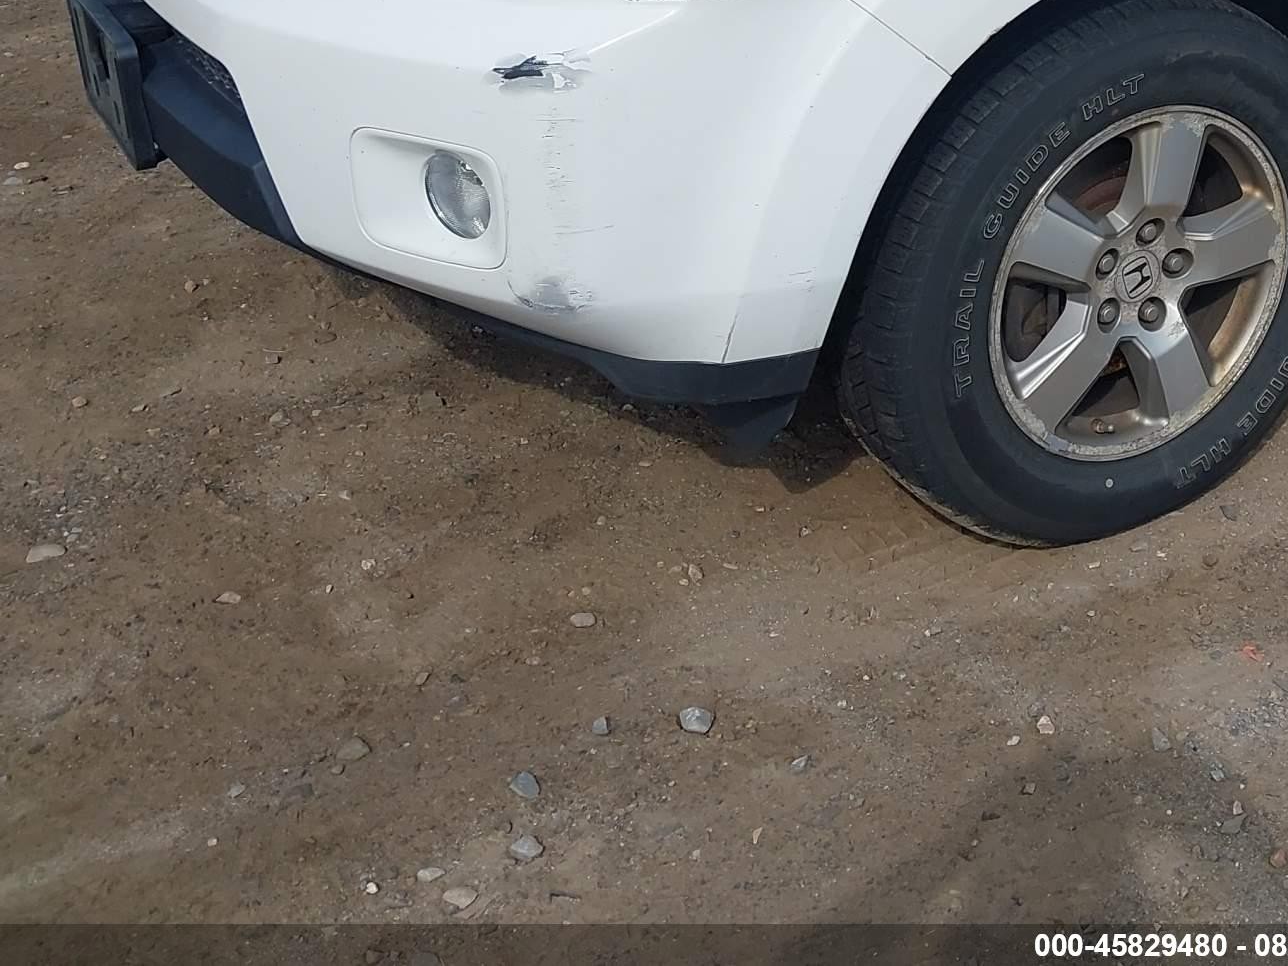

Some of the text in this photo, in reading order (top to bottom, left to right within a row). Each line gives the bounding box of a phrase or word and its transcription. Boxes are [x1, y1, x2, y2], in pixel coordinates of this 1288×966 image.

[953, 73, 1145, 398] TRAIL GUIDE HLT
[1176, 437, 1232, 489] HLT
